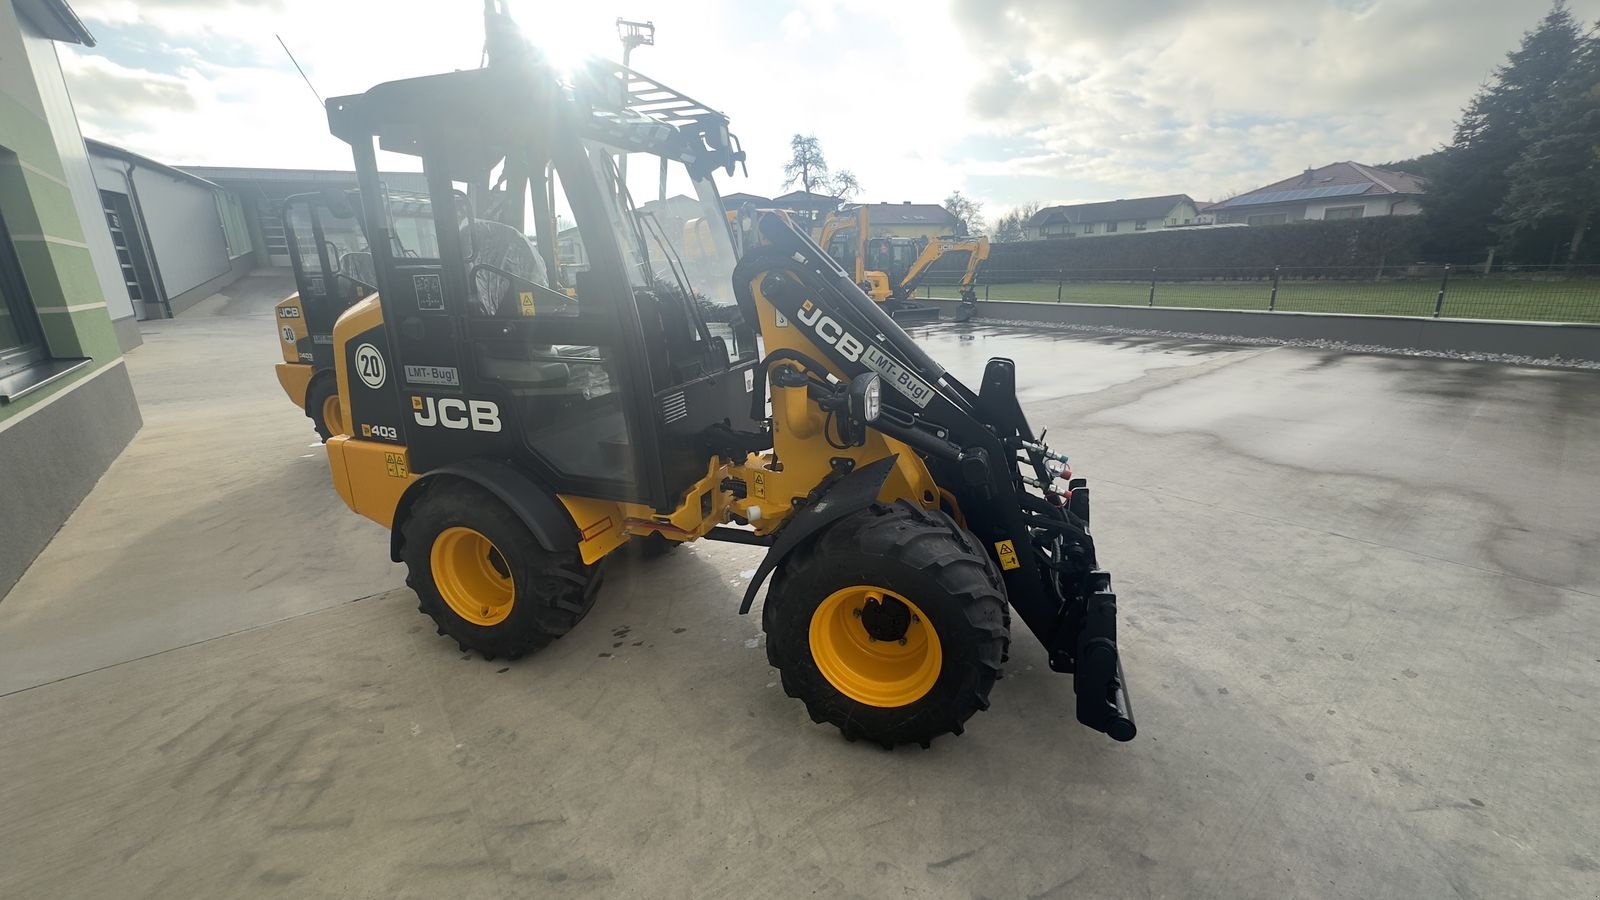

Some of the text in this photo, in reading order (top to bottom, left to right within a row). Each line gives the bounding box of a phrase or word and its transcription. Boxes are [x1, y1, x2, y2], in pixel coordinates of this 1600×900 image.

[279, 307, 300, 318] JCB
[283, 327, 295, 341] 30
[797, 307, 864, 363] JCB
[361, 354, 380, 378] 20
[414, 397, 502, 433] JCB
[371, 425, 397, 439] 403
